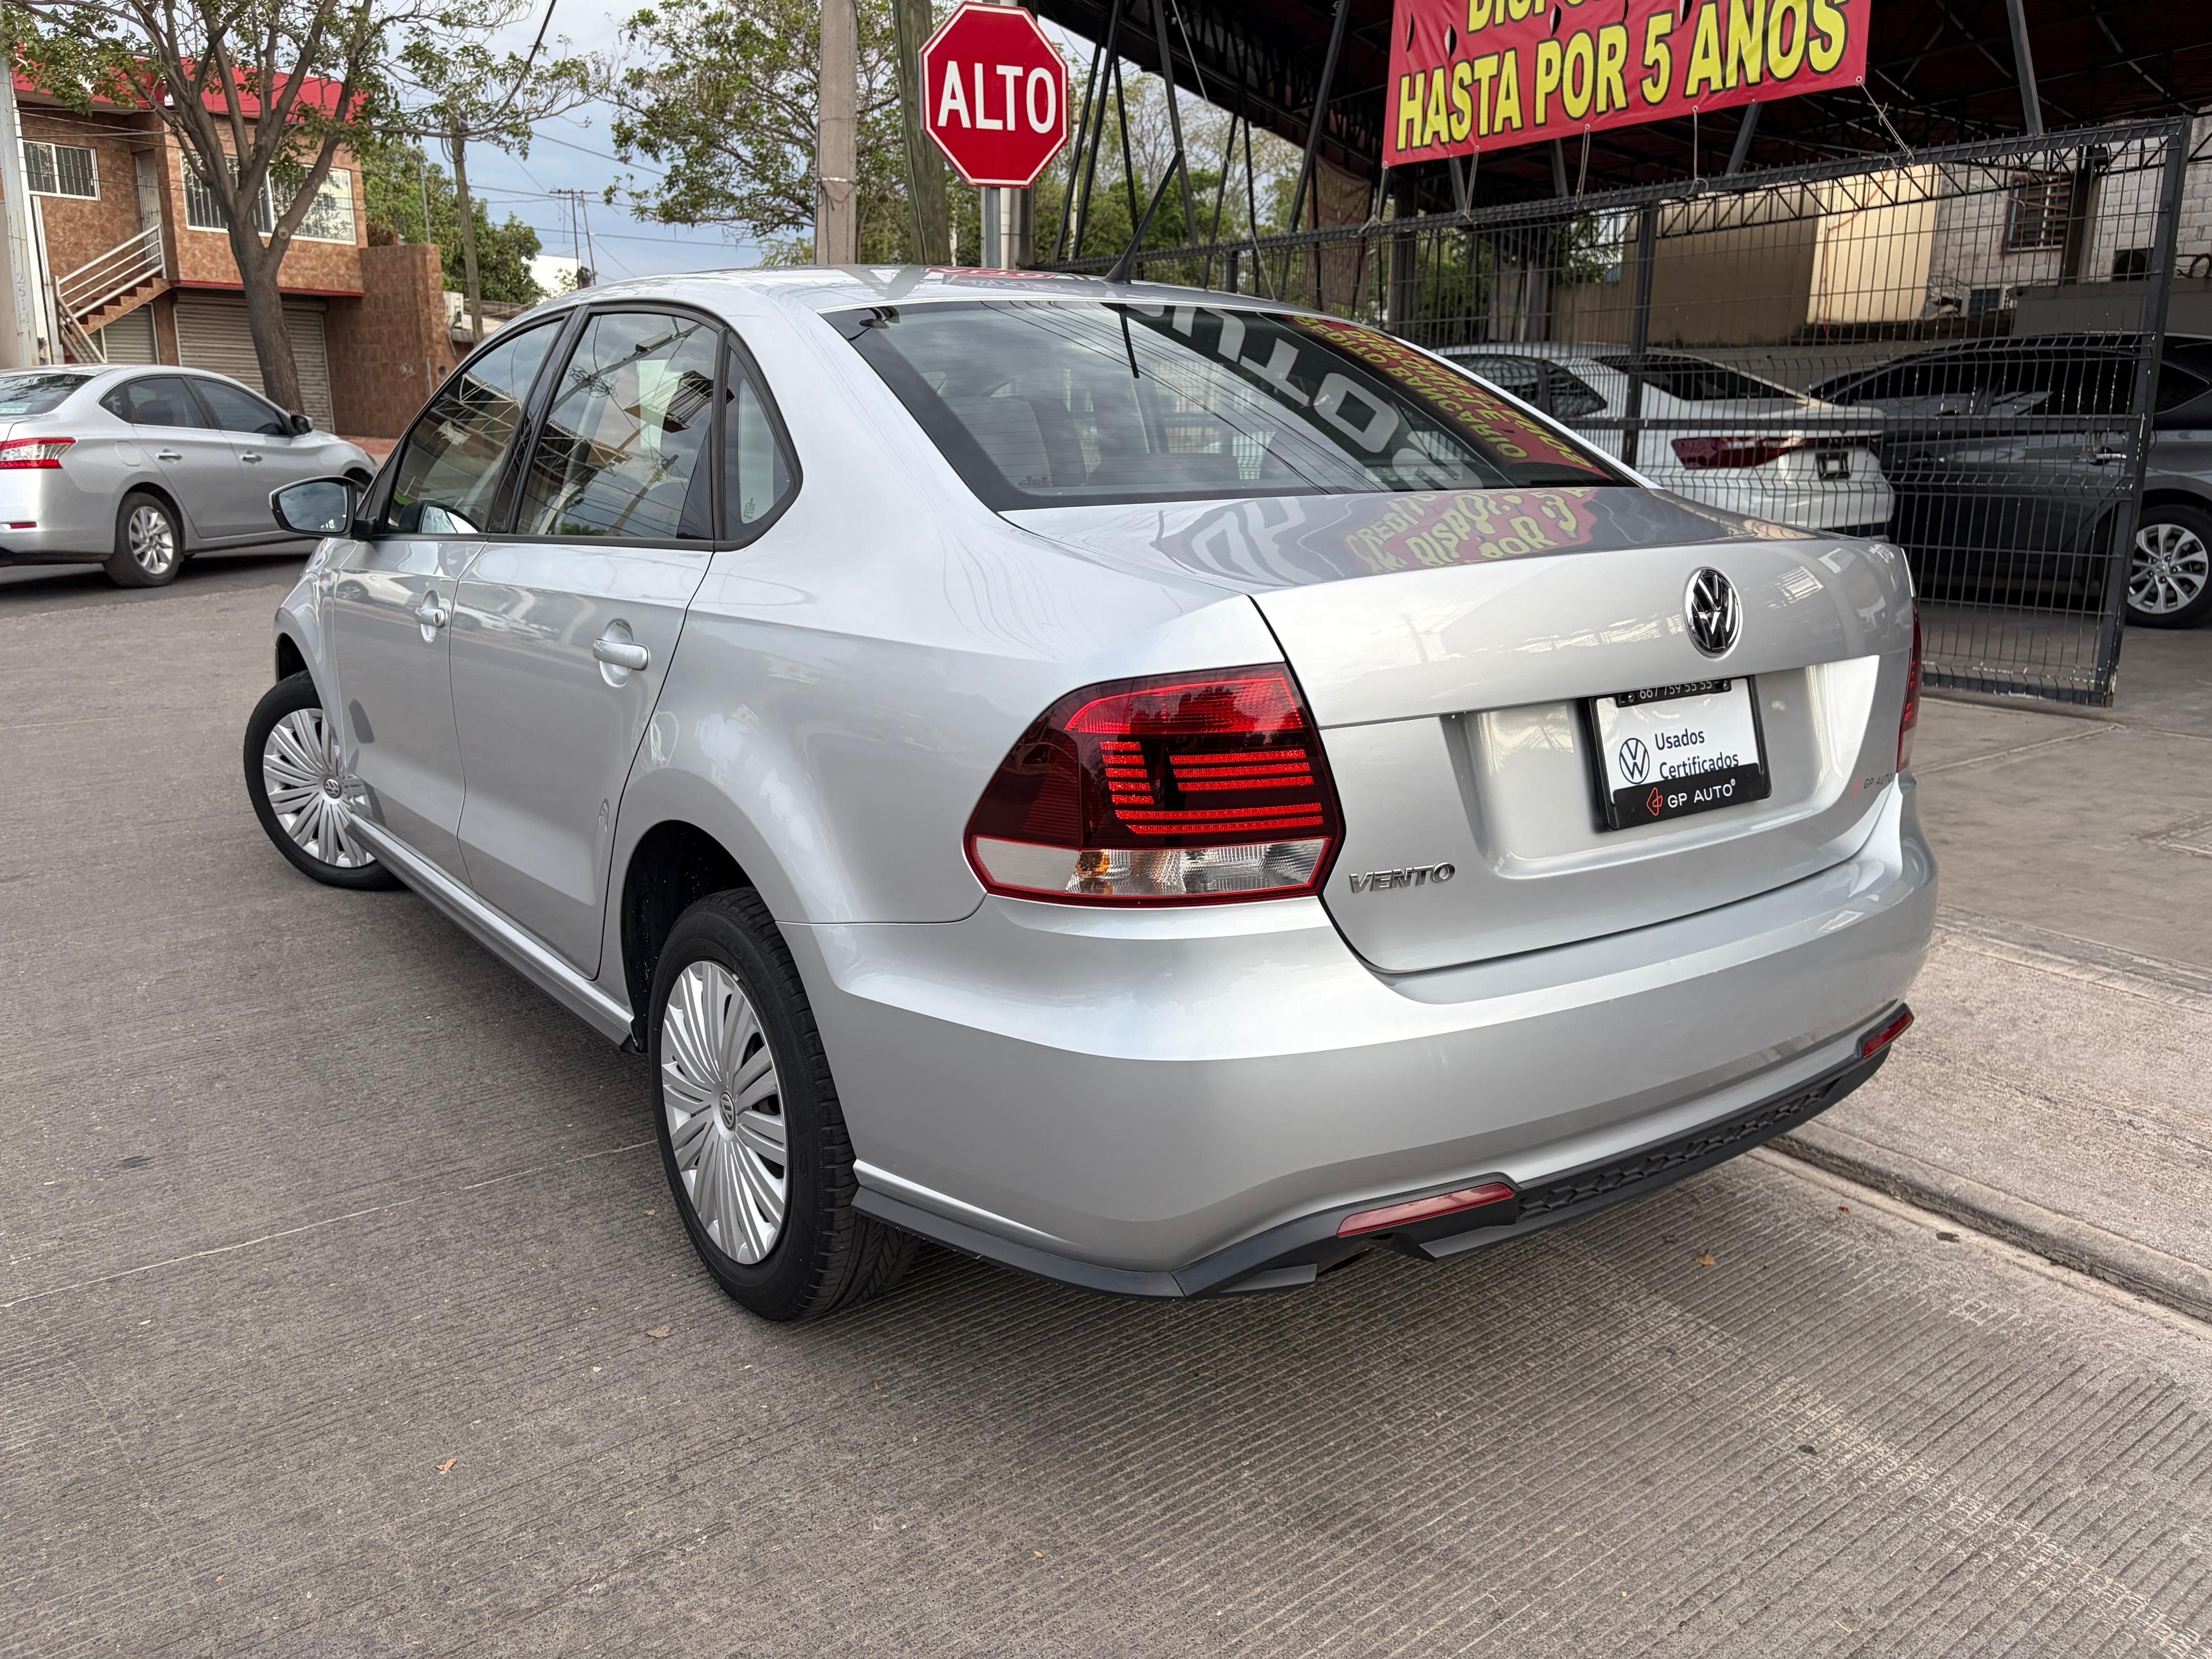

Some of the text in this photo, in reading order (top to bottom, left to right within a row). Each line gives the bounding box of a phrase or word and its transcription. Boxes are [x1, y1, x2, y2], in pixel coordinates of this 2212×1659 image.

[1396, 48, 1523, 150] HASTA
[1535, 22, 1628, 125] POR
[1641, 9, 1674, 104] 5
[937, 60, 1056, 133] ALTO
[1655, 728, 1705, 750] Usados
[1659, 752, 1739, 780] Certificados
[1864, 773, 1893, 789] GP AUTO
[1668, 792, 1687, 808] GP
[1349, 861, 1455, 894] VENTO
